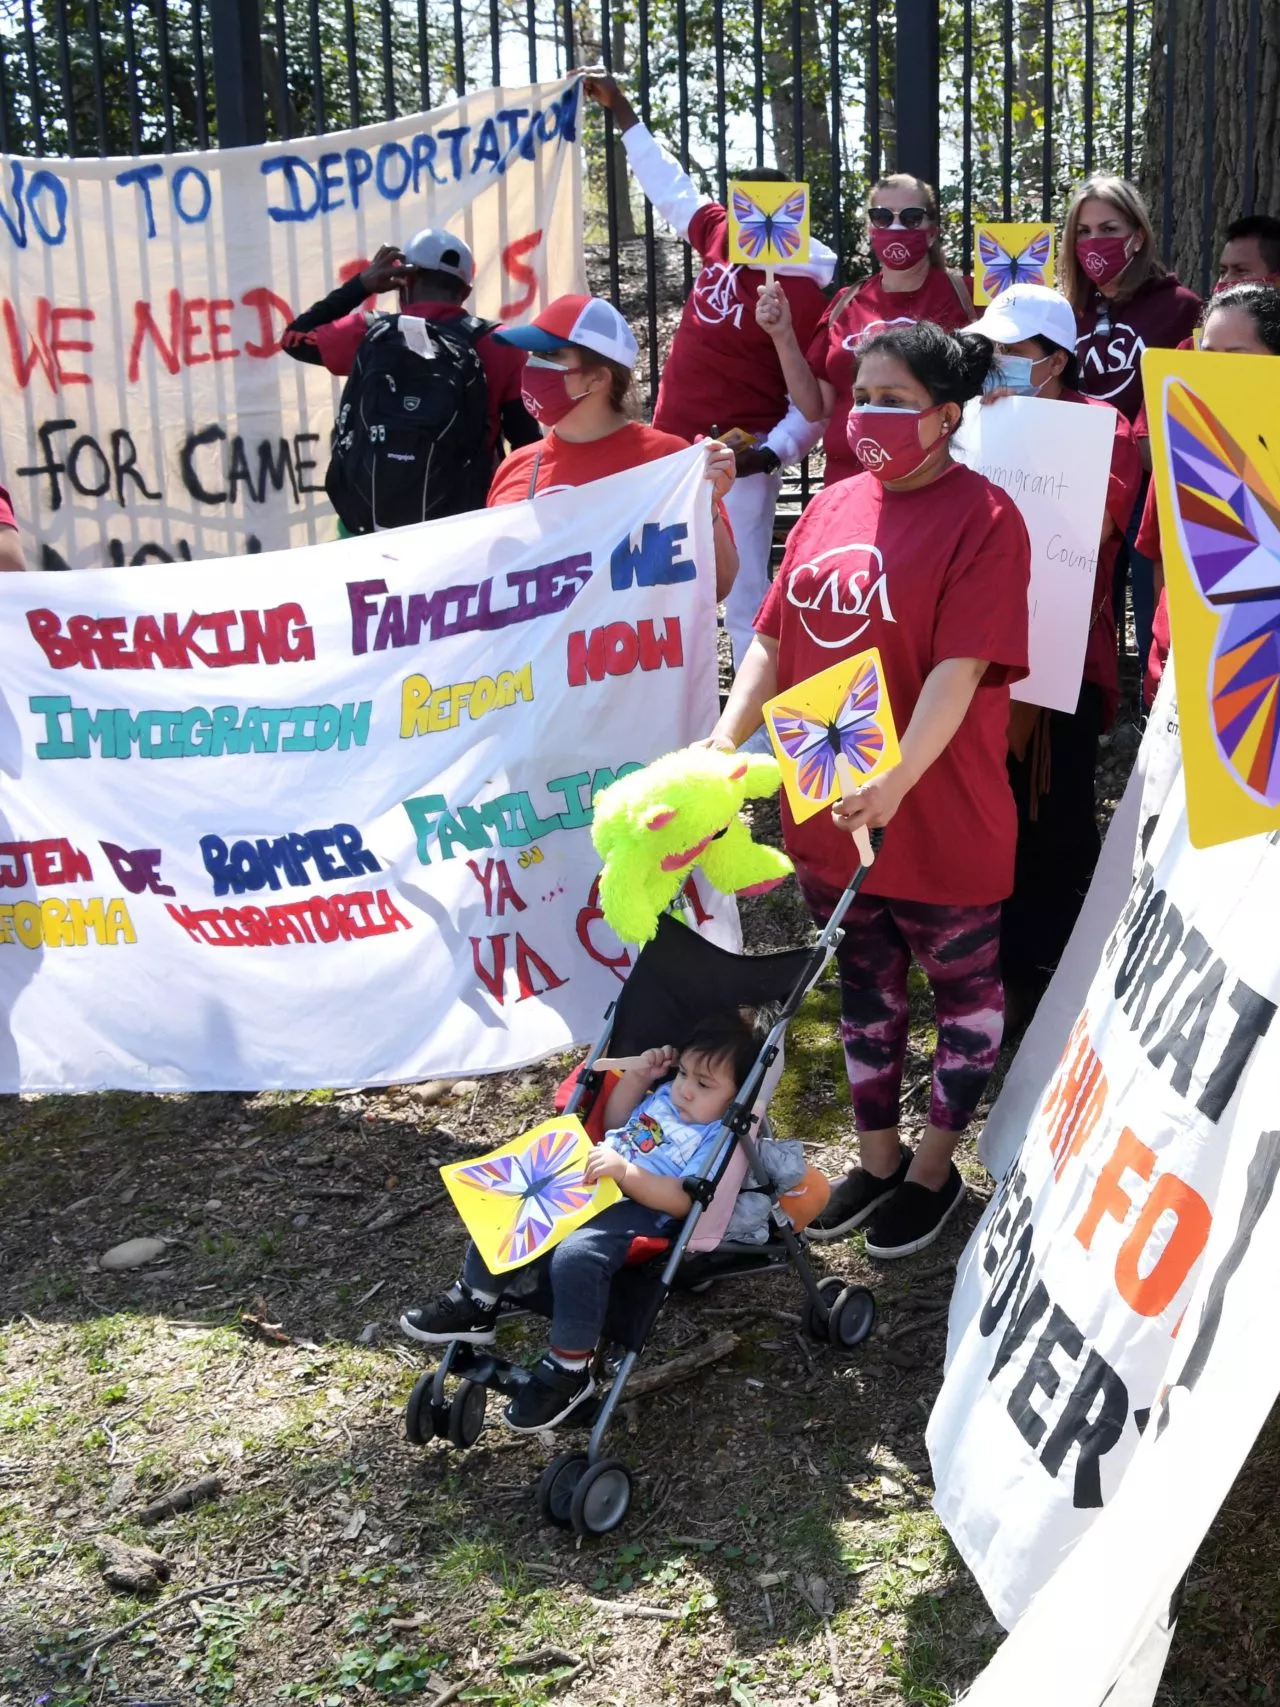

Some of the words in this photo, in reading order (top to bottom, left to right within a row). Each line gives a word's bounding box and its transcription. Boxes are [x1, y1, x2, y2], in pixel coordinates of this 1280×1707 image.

[0, 160, 68, 248] NO
[116, 163, 212, 239] TO
[3, 297, 95, 394] WE
[128, 288, 294, 384] NEED
[1074, 335, 1147, 378] ASA
[16, 418, 162, 511] FOR
[856, 446, 893, 464] CASA
[25, 602, 316, 670] BREAKING
[346, 551, 593, 656] FAMILIES
[611, 521, 697, 591] WE
[786, 563, 897, 624] CASA
[29, 694, 373, 760] IMMIGRATION
[399, 661, 535, 739] REFORM
[566, 616, 684, 687] NOW
[98, 839, 176, 897] DE
[199, 823, 382, 897] ROMPER
[164, 889, 413, 947] MIGRATORIA
[1073, 1126, 1213, 1339] FO
